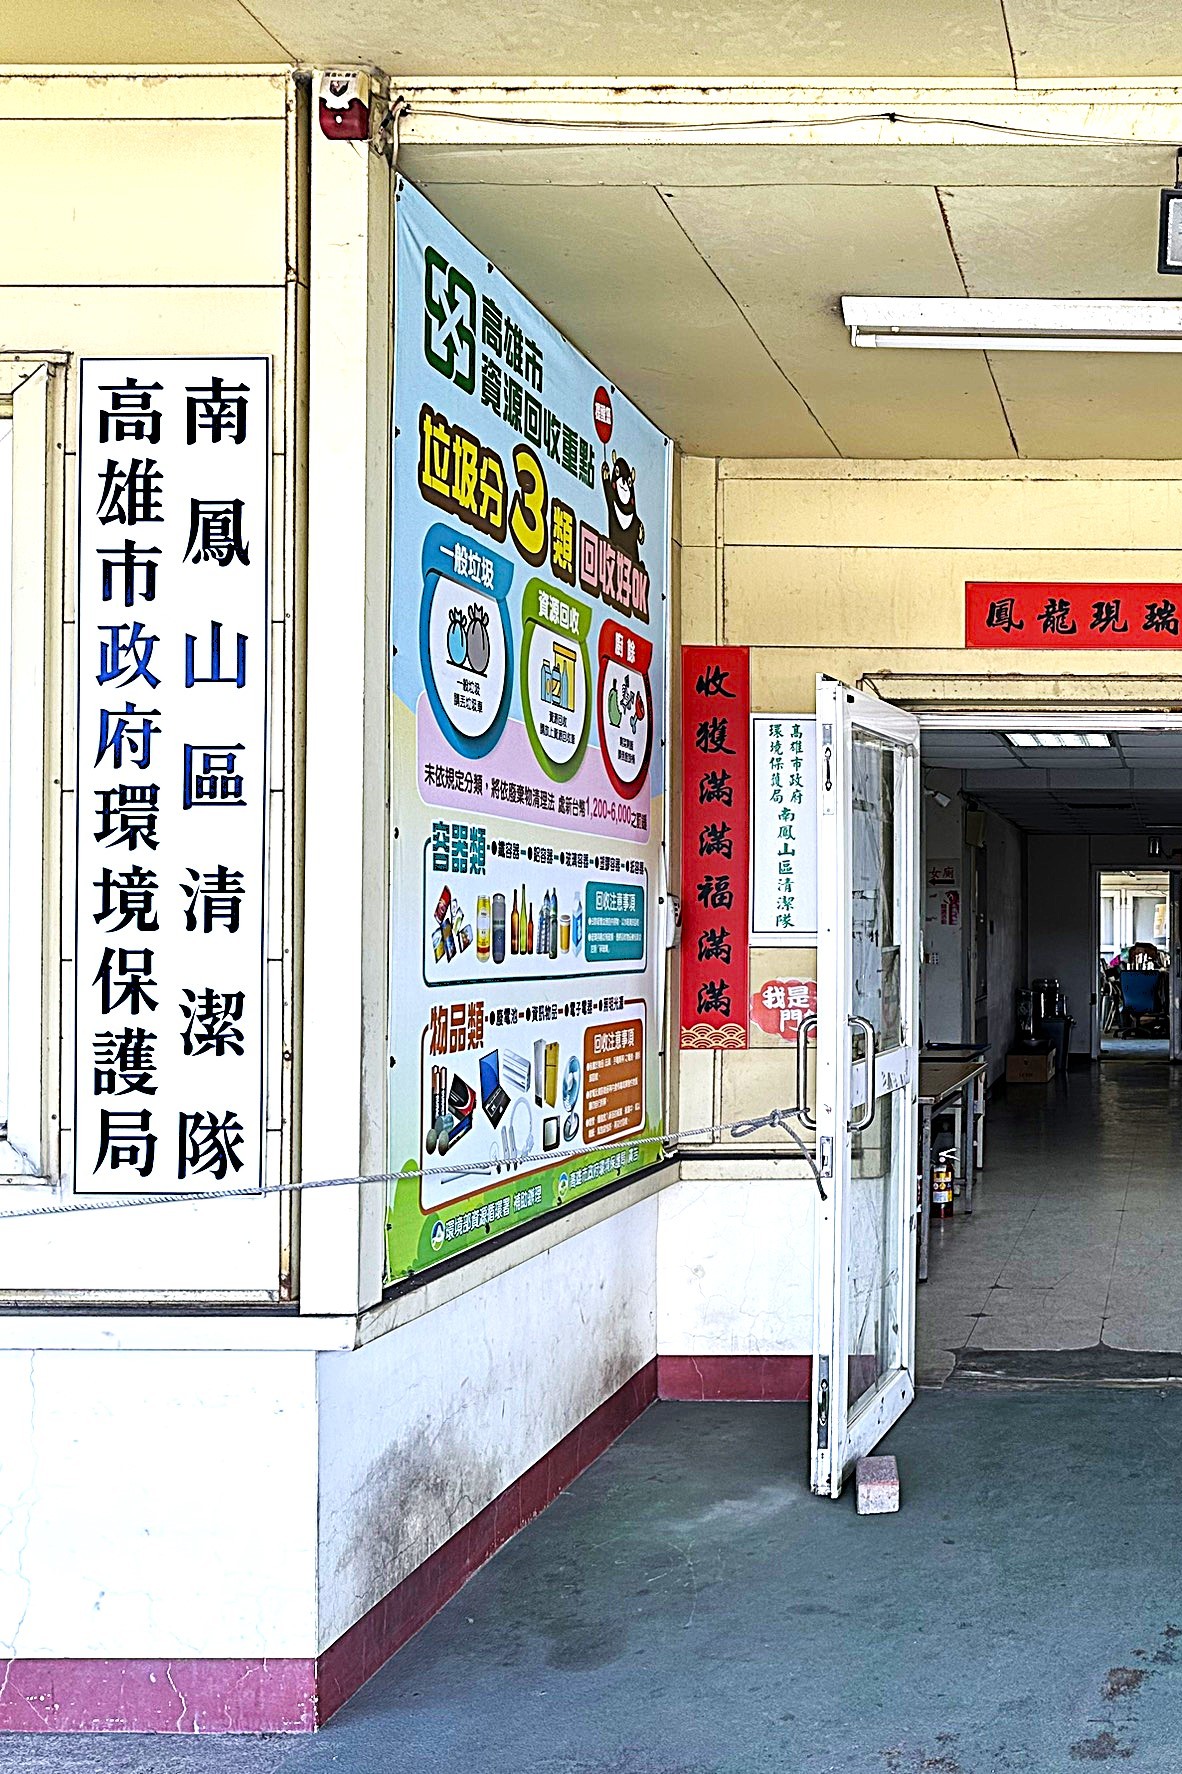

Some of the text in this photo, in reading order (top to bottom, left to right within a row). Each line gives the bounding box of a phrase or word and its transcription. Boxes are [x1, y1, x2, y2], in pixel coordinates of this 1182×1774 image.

[481, 294, 543, 393] 高雄市
[480, 353, 595, 490] 資源回收重點
[439, 542, 495, 591] 一般垃圾
[537, 589, 580, 636] 資源回收
[92, 377, 164, 1178] 高雄市政府環境保護局
[178, 376, 250, 1181] 南鳳山區清潔隊
[789, 724, 804, 804] 高雄市政府
[432, 820, 486, 876] 容器類
[776, 807, 796, 929] 南鳳山區清潔隊
[429, 1001, 485, 1056] 物品類
